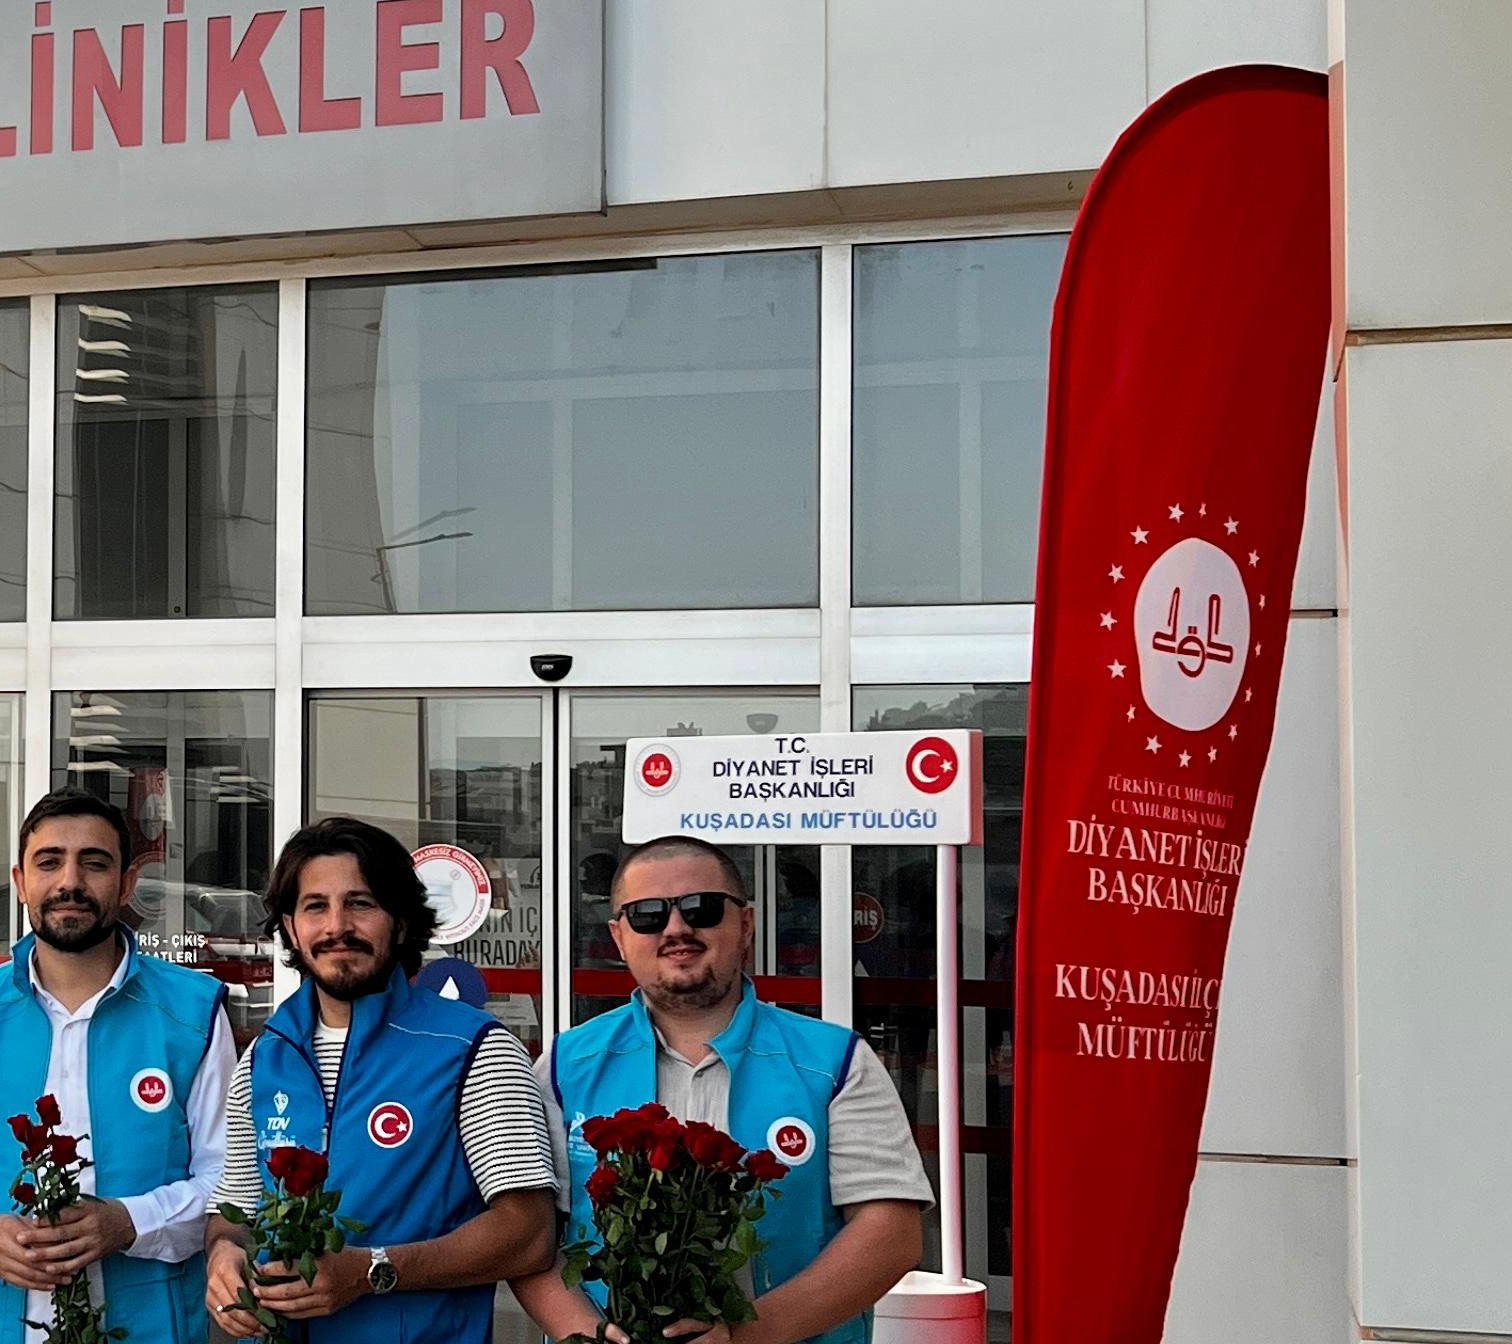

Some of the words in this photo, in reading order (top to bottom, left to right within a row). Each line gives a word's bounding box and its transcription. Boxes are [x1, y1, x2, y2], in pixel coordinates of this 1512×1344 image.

[774, 736, 811, 755] T.C.
[712, 757, 801, 779] DİYANET
[809, 754, 874, 780] İŞLERİ
[728, 778, 856, 804] BAŞKANLIĞI
[679, 811, 792, 833] KUŞADASI
[800, 807, 938, 830] MÜFTÜLÜĞÜ
[1066, 813, 1193, 868] DİYANET
[1192, 828, 1245, 880] İŞLER
[1087, 867, 1229, 917] BAŞKANLIĞI
[854, 906, 879, 931] RİŞ
[171, 933, 206, 949] ÇIKIŞ
[1054, 963, 1190, 1012] KUŞADASI
[1076, 1015, 1214, 1063] MÜFTÜLÜĞÜ
[267, 1116, 291, 1131] TDV
